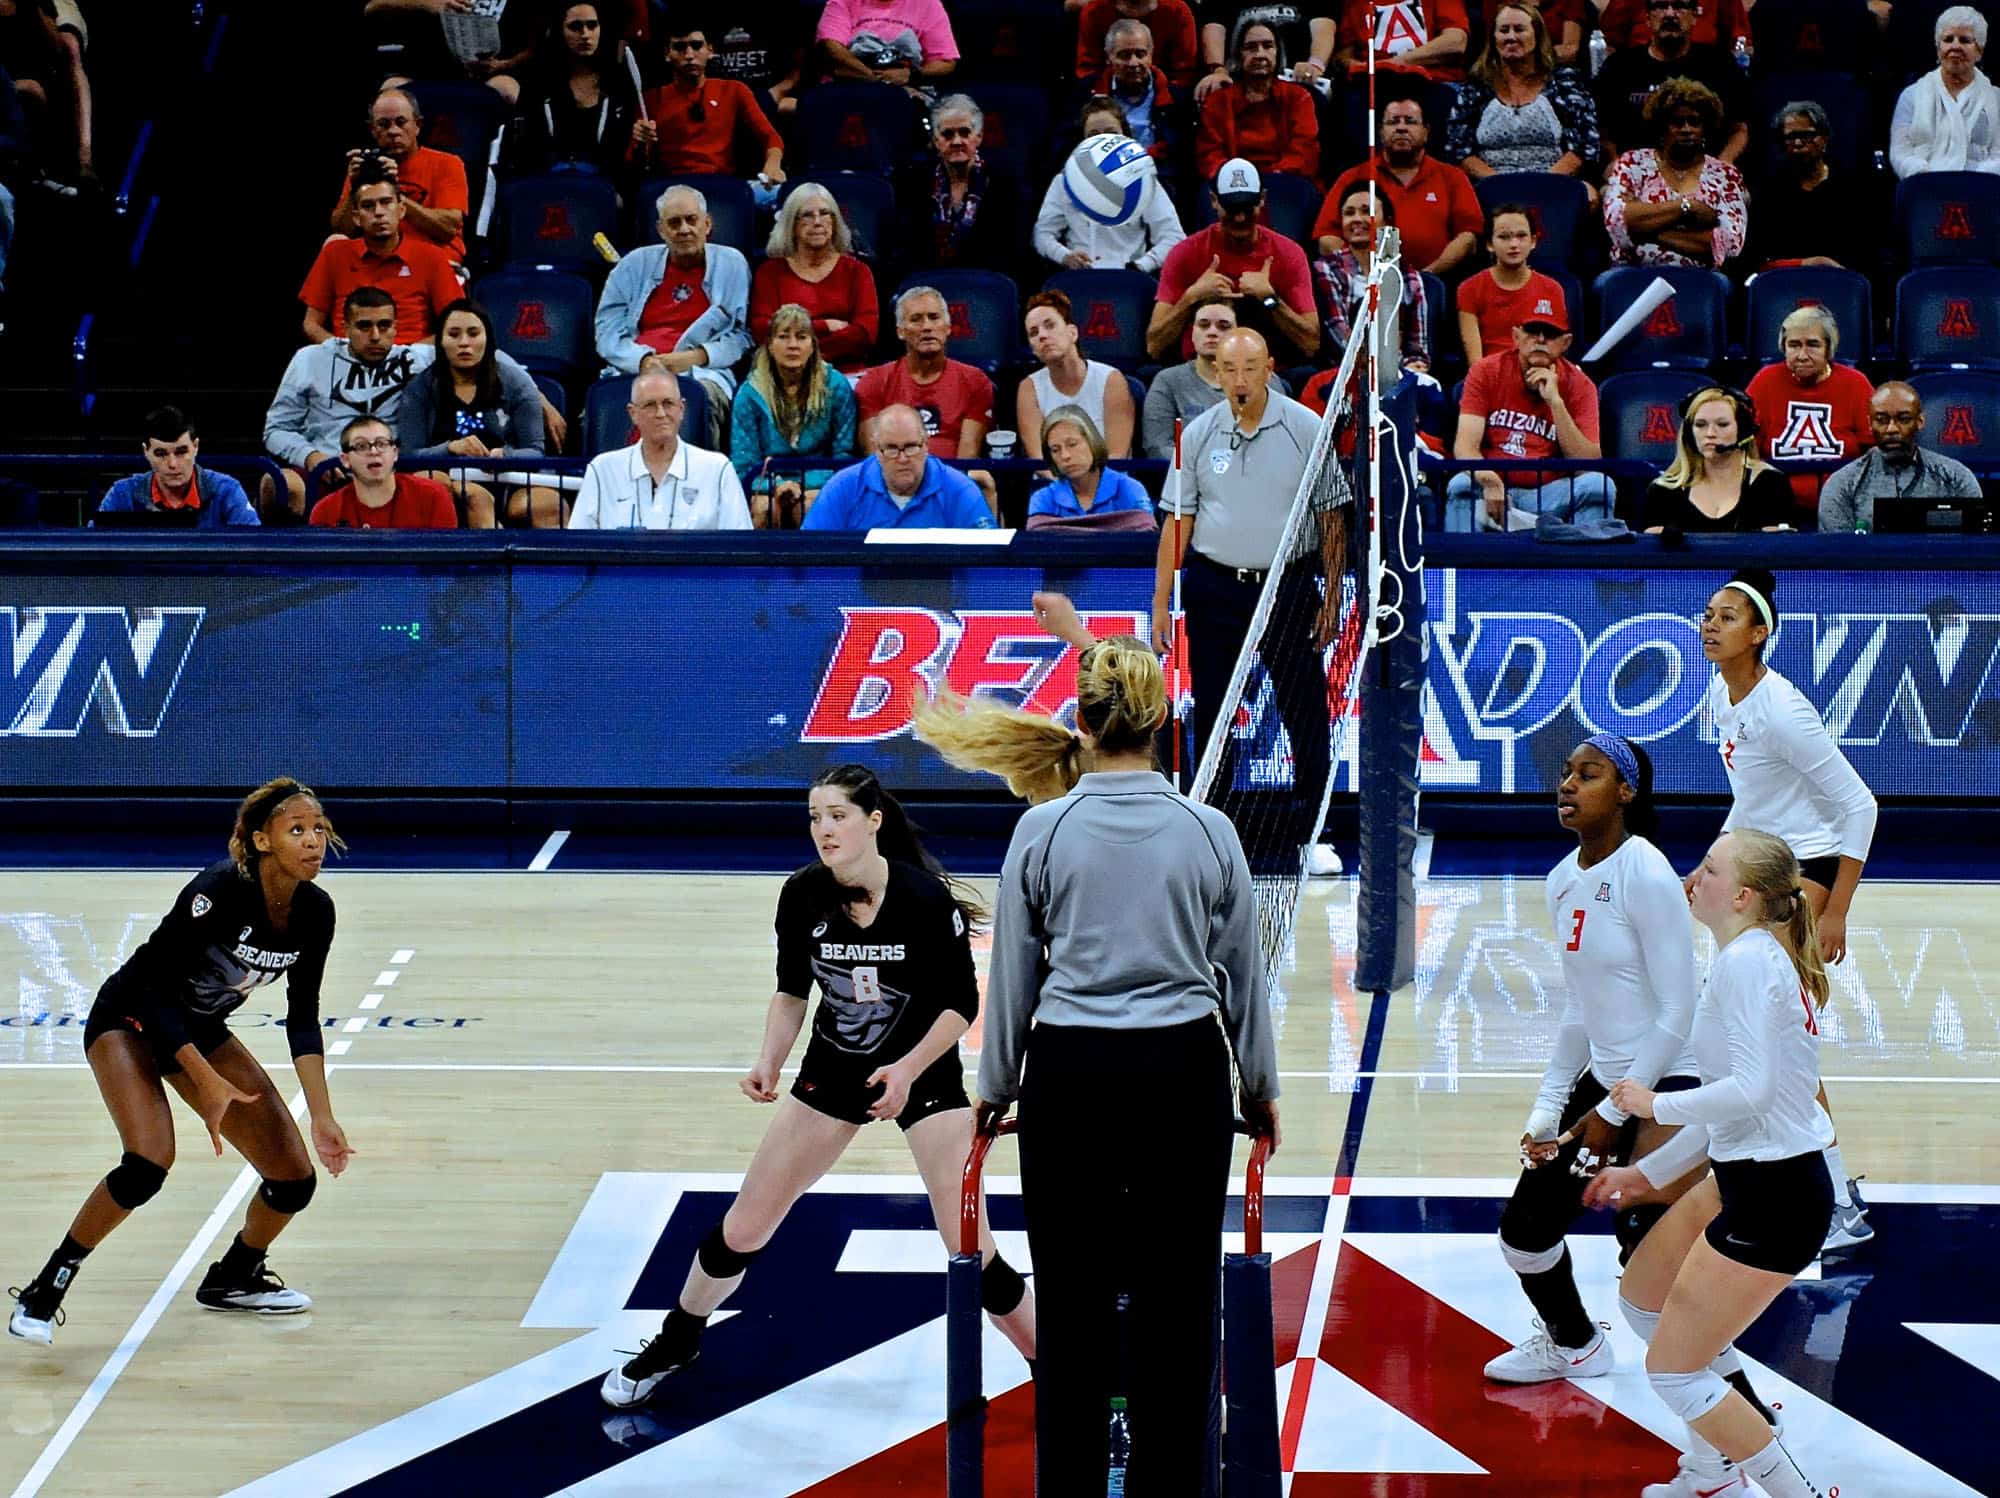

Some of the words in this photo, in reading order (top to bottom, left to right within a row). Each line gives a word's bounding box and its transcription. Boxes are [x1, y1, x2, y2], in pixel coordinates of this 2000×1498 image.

[1230, 169, 1249, 188] A
[1935, 203, 1977, 240] A
[511, 301, 551, 337] A
[1084, 303, 1120, 340] A
[1936, 299, 1980, 338] A
[1488, 408, 1558, 441] ARIZONA
[1640, 404, 1677, 443] A
[1771, 401, 1844, 460] A
[1939, 406, 1980, 445] A
[1566, 909, 1586, 952] 3
[232, 942, 300, 969] BEAVERS
[820, 942, 906, 962] BEAVERS
[852, 965, 881, 1004] 8
[223, 1013, 486, 1030] Cter
